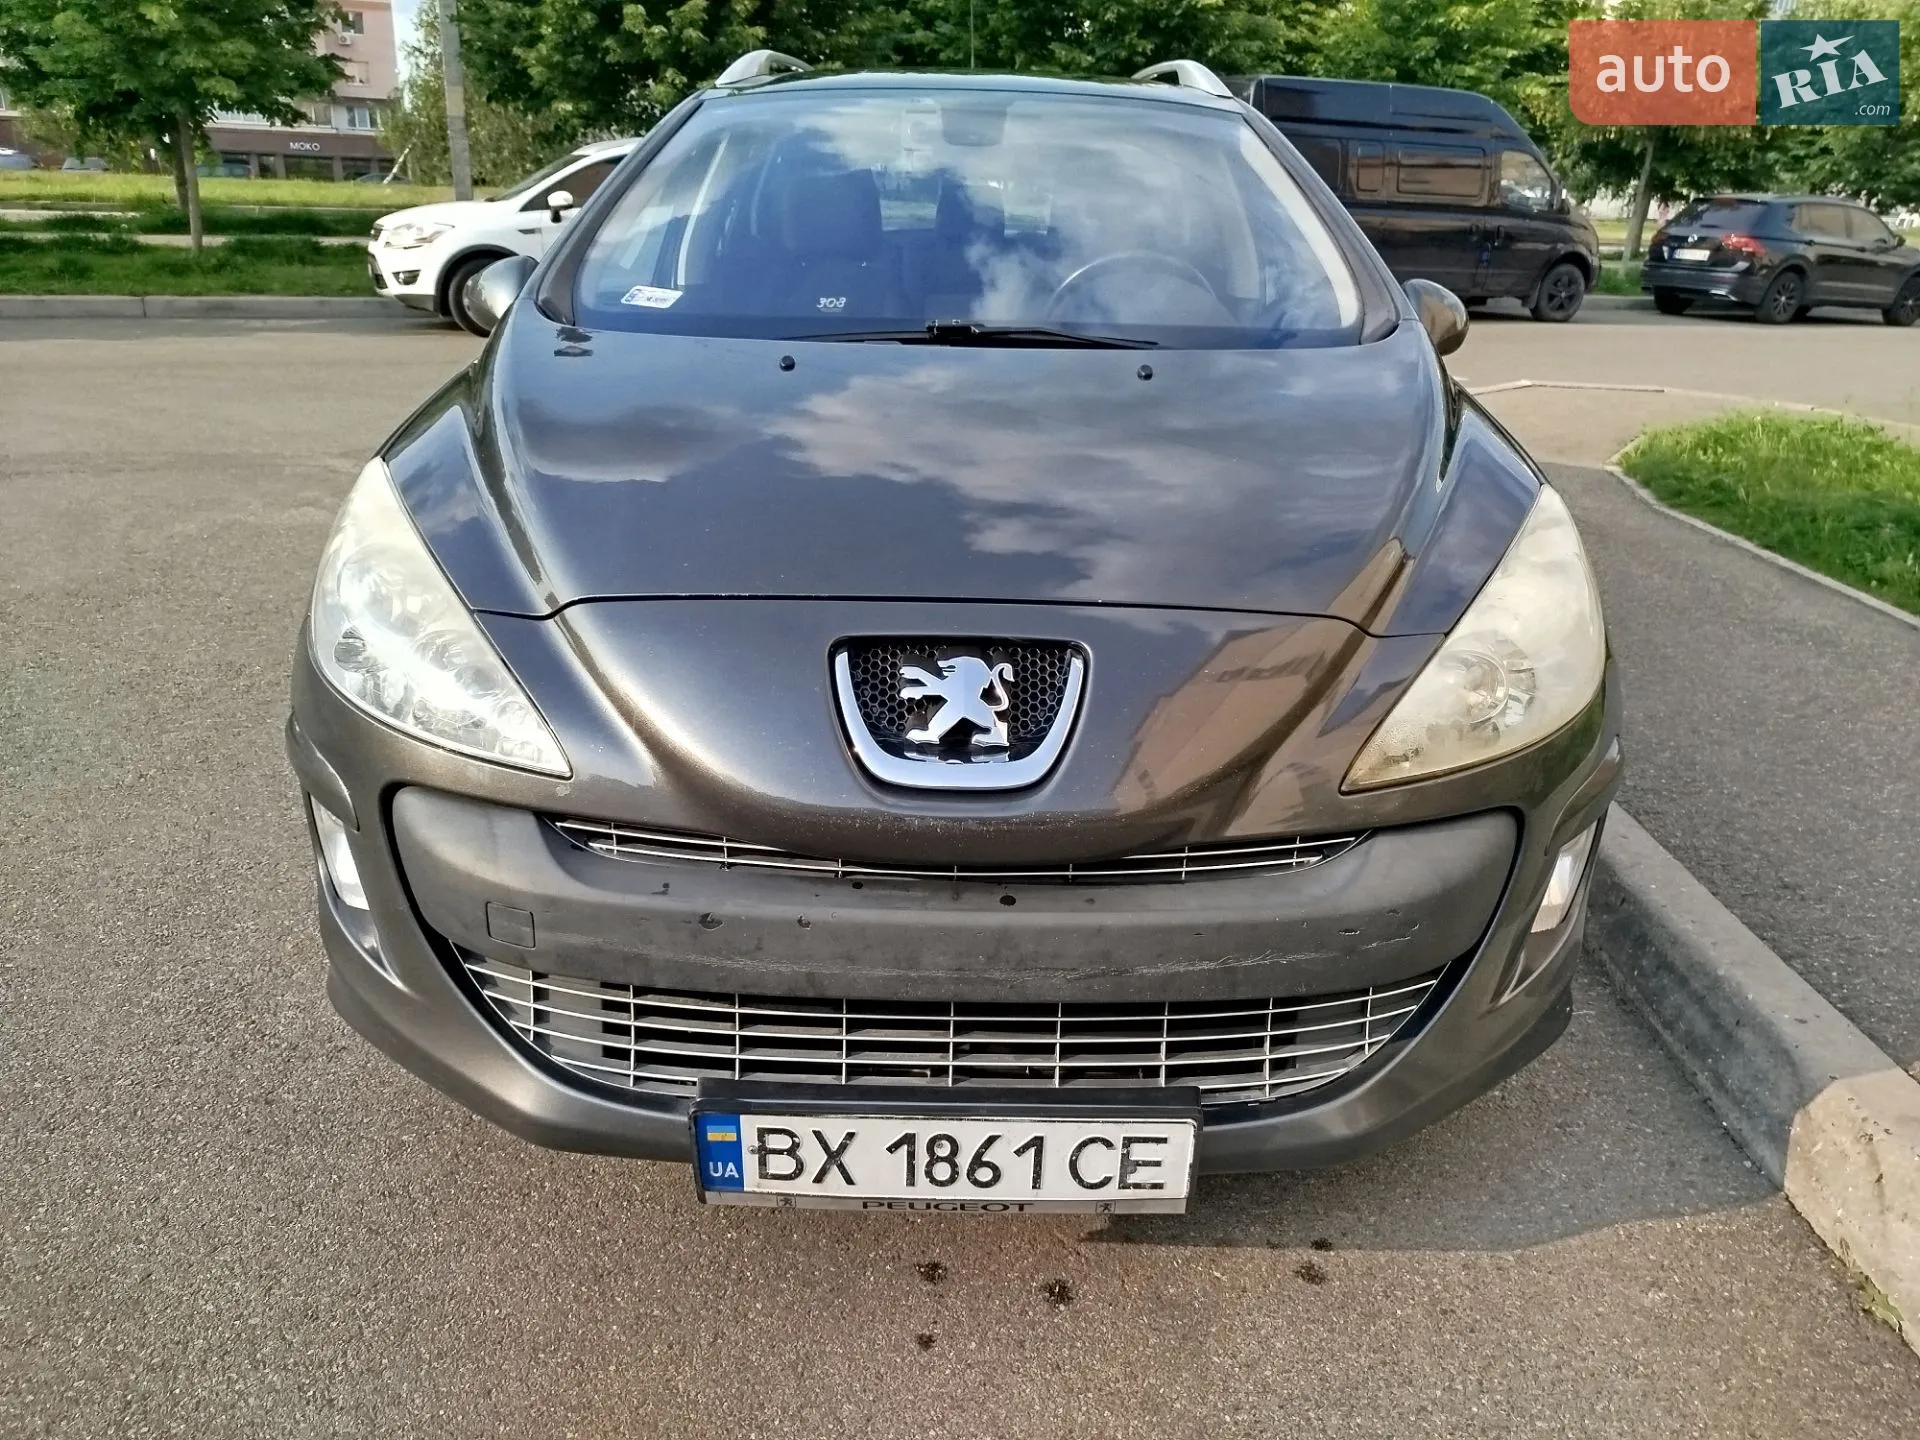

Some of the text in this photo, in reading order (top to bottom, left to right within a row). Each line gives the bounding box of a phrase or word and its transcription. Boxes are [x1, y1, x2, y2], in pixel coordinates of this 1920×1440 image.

[290, 142, 320, 151] MOKO
[816, 297, 847, 308] 308
[756, 1126, 1168, 1190] BX 1861 CE
[709, 1161, 739, 1178] UA
[863, 1200, 1034, 1212] PEUGEOT
